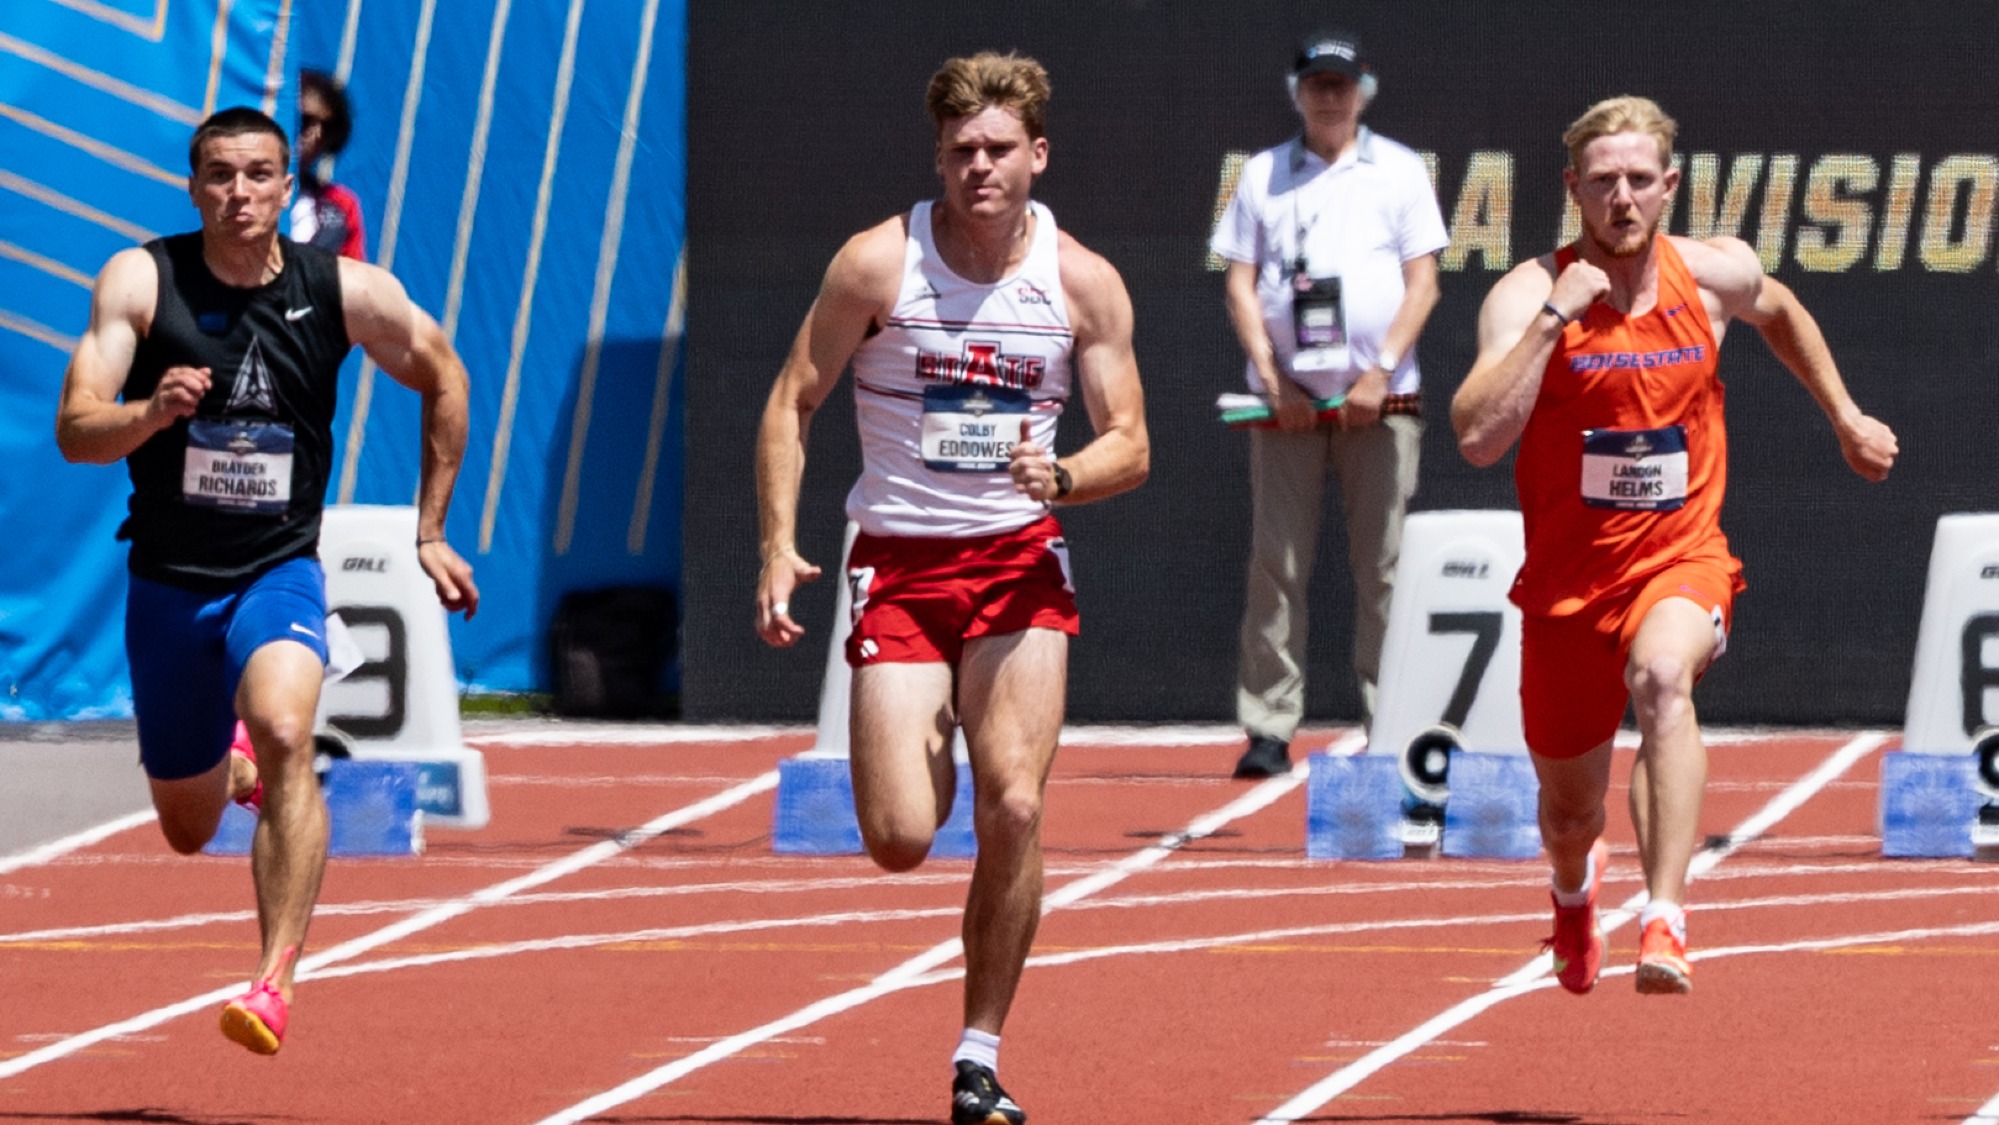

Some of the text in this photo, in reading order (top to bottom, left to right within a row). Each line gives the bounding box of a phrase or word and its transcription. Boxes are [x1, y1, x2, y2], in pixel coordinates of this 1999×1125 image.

[959, 423, 997, 437] COLBY
[939, 440, 1016, 458] EDDOWES
[198, 474, 278, 497] RICHARDS
[1609, 480, 1664, 497] HELMS
[1427, 611, 1504, 731] 7
